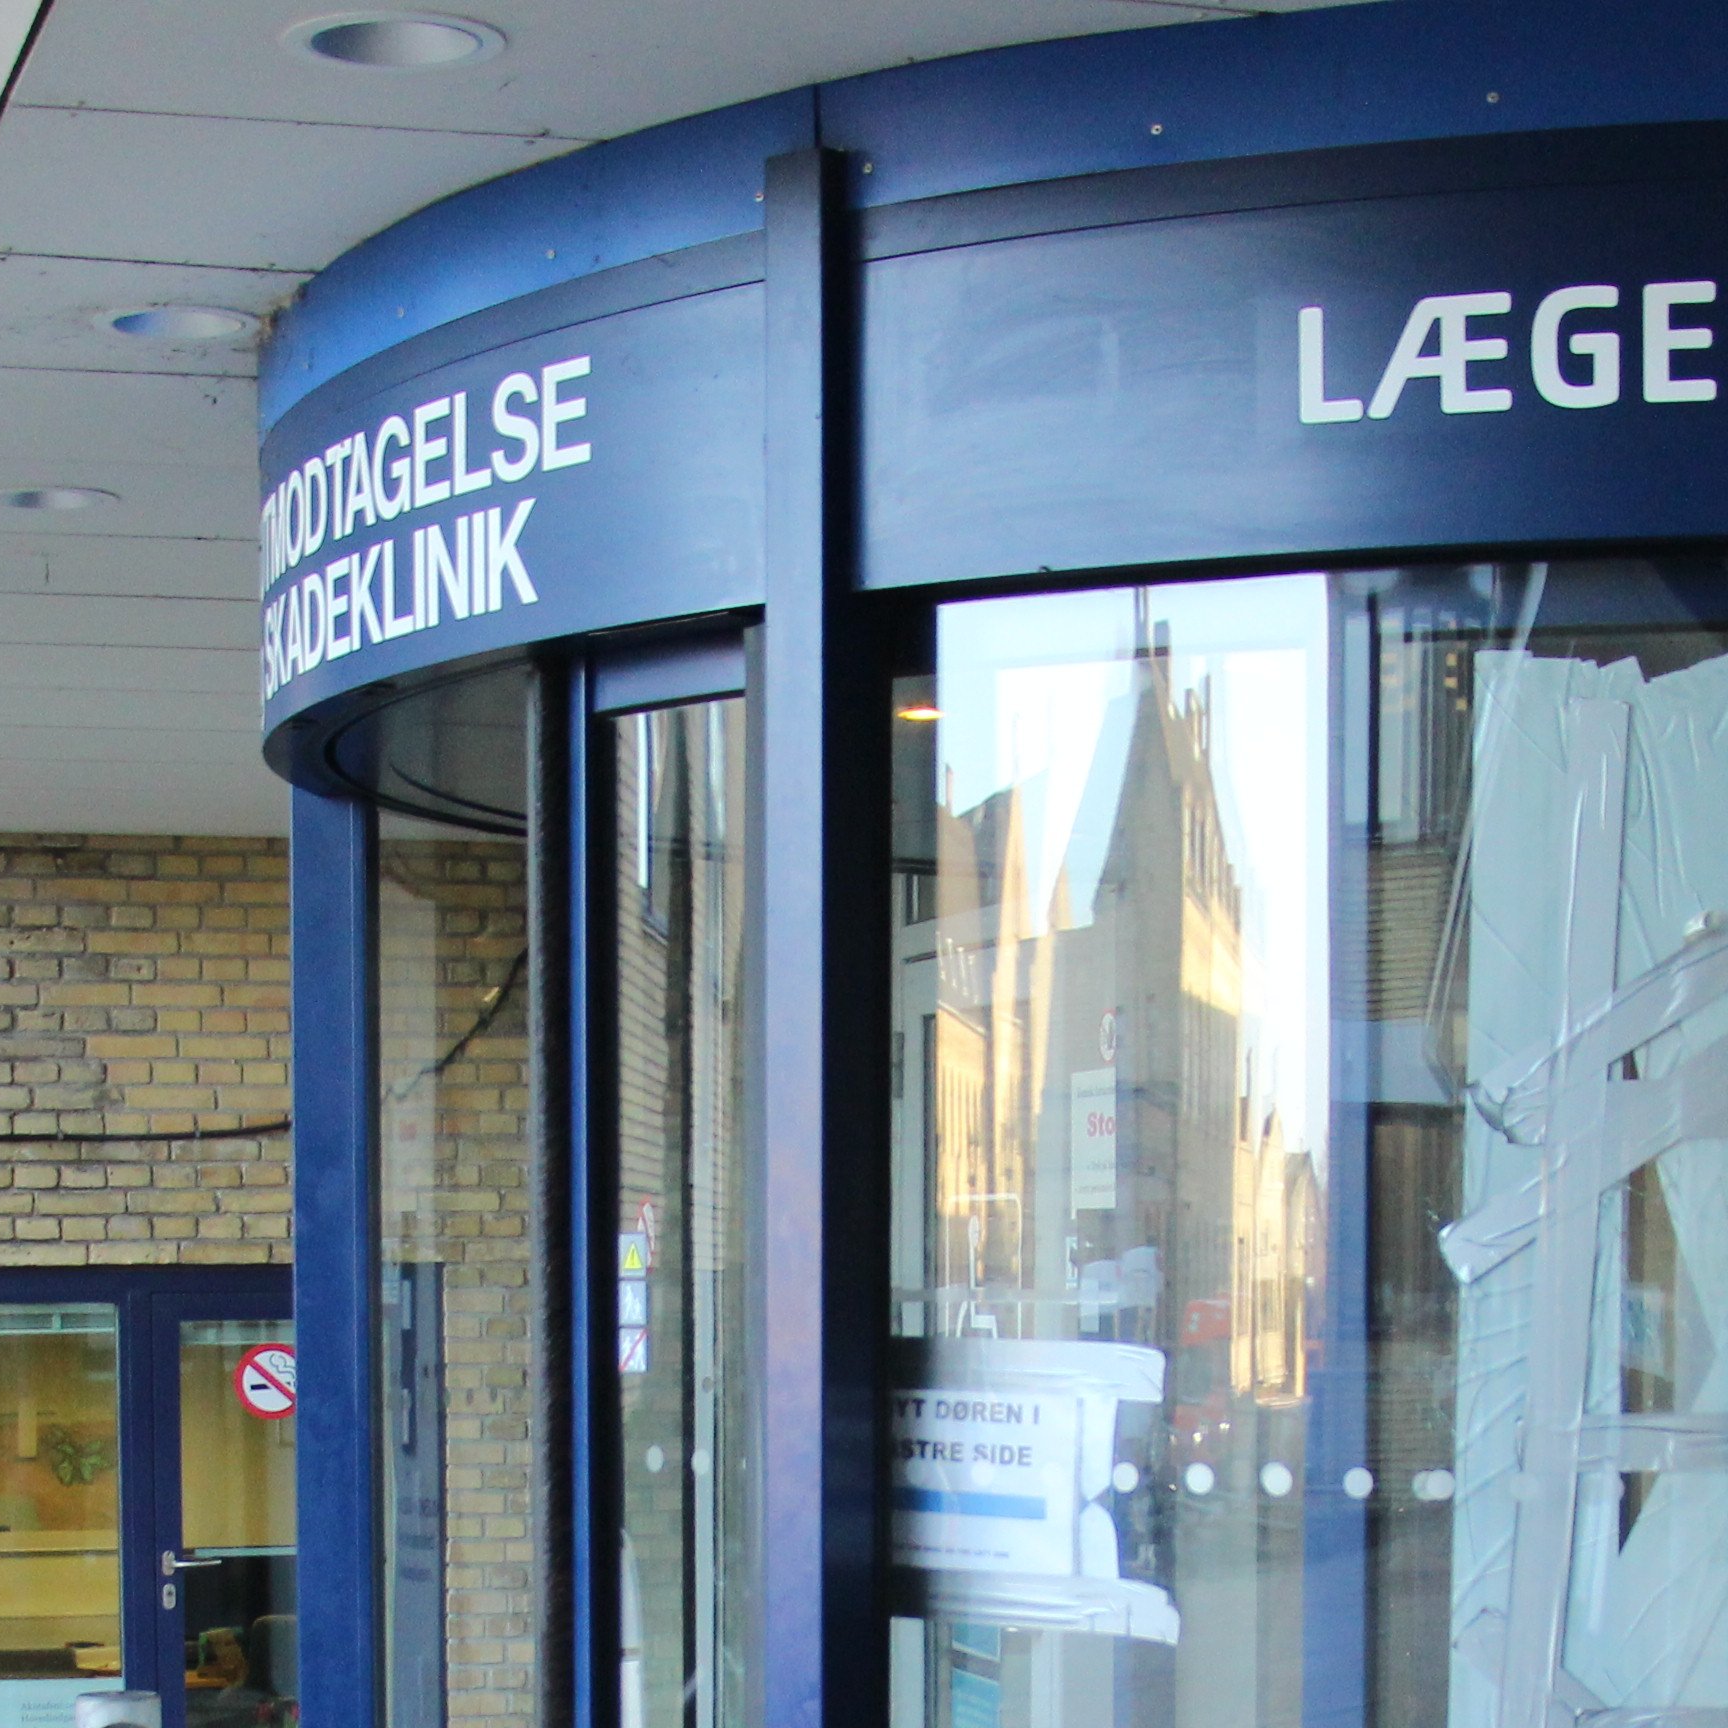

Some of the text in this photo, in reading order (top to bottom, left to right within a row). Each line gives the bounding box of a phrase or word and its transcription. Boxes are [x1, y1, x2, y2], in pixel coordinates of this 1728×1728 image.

[263, 497, 540, 702] SKADEKLINIK
[935, 1399, 1023, 1424] DØREN
[1032, 1403, 1042, 1425] I
[972, 1442, 1033, 1467] SIDE
